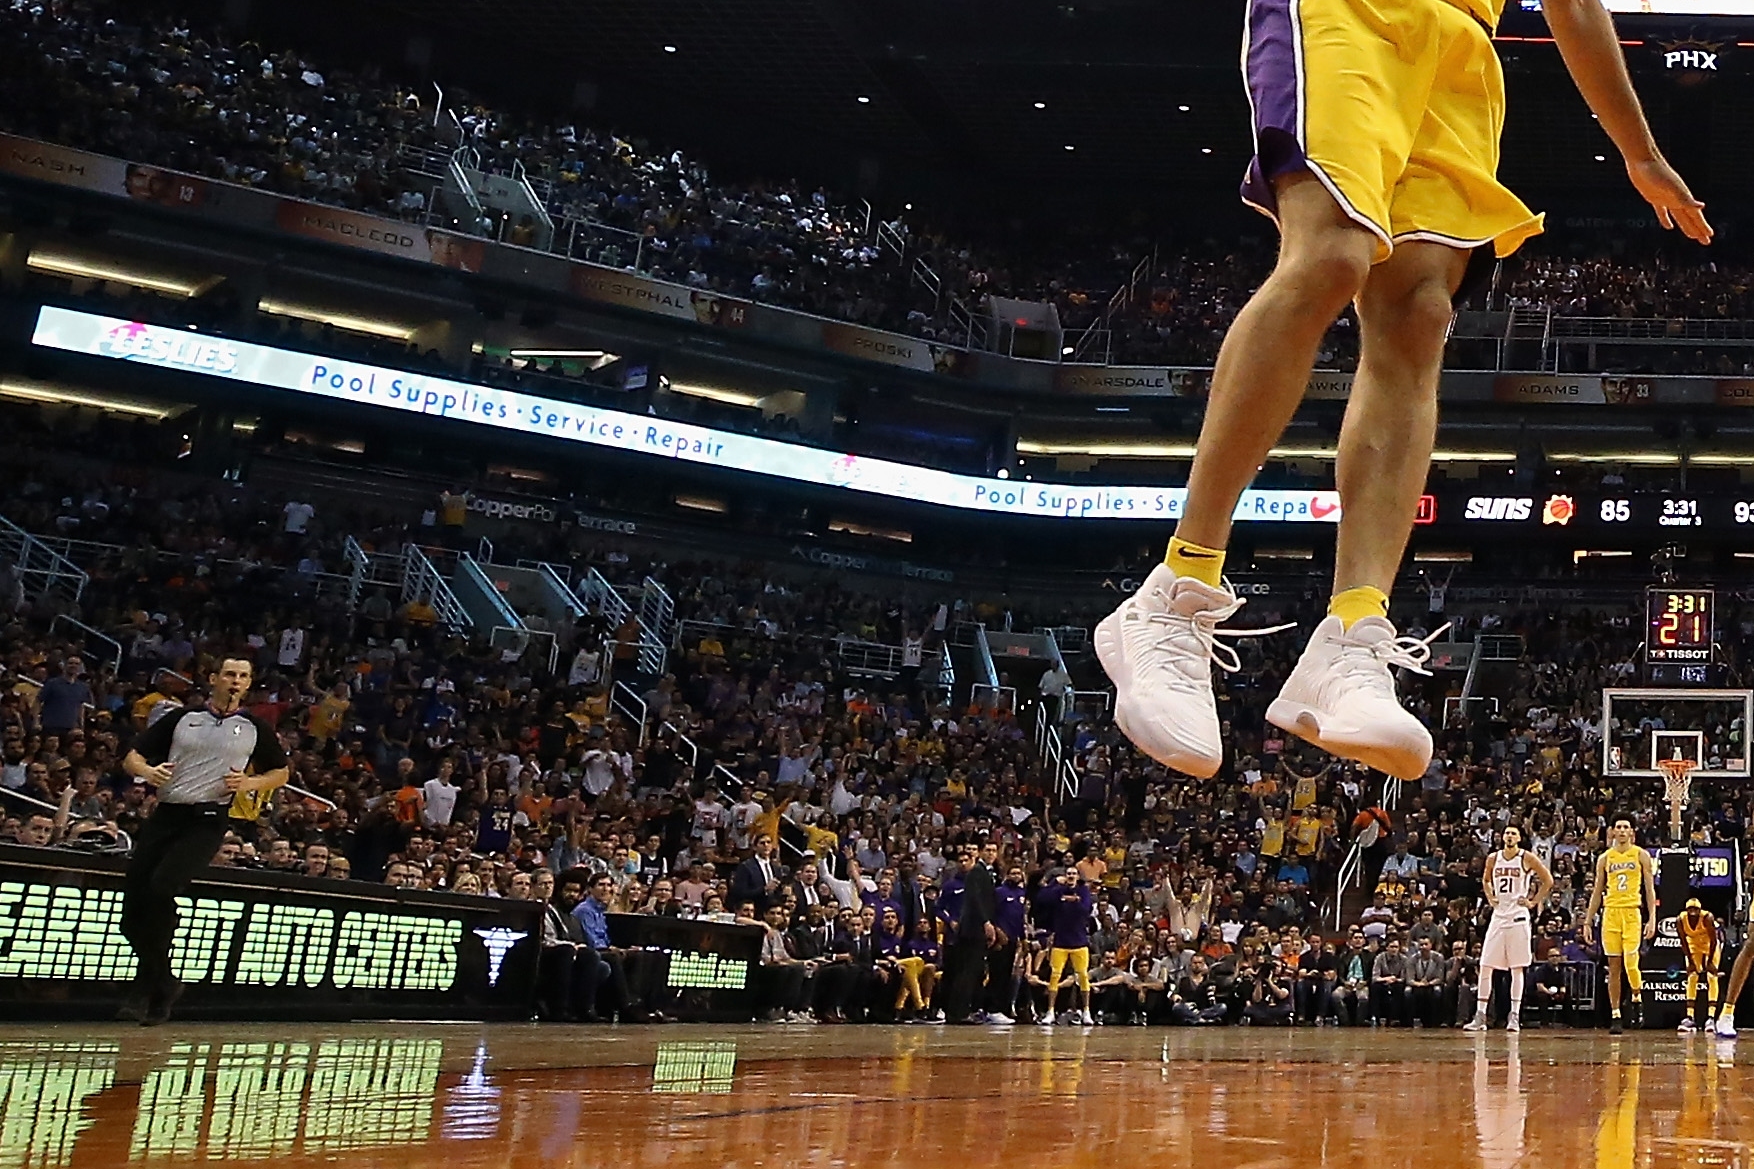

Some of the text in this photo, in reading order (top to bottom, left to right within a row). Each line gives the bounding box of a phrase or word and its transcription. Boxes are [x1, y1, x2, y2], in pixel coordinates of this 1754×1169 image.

[1664, 49, 1718, 71] PHX
[11, 151, 85, 176] NASH
[303, 215, 415, 248] MACLEOD
[1308, 381, 1352, 392] AWKI
[1518, 383, 1580, 396] ADAMS
[312, 364, 725, 459] Pool Supplies Service Repair
[974, 484, 1025, 506] Pool
[1036, 490, 1135, 517] Supplies
[1253, 495, 1308, 522] Repa
[1662, 499, 1698, 516] 3:31
[1600, 499, 1631, 522] 85
[1658, 515, 1692, 526] Quarter
[1667, 594, 1706, 613] 3:31
[1659, 614, 1700, 645] 21
[1665, 649, 1709, 660] TISSOT
[1494, 866, 1521, 879] SUNS
[1499, 878, 1513, 894] 21
[1616, 873, 1629, 892] 2
[234, 902, 336, 989] AUTO
[331, 910, 464, 993] CENTERS
[1654, 936, 1683, 948] ARIZO
[1680, 980, 1708, 991] SCK
[1655, 990, 1688, 1002] RESOR
